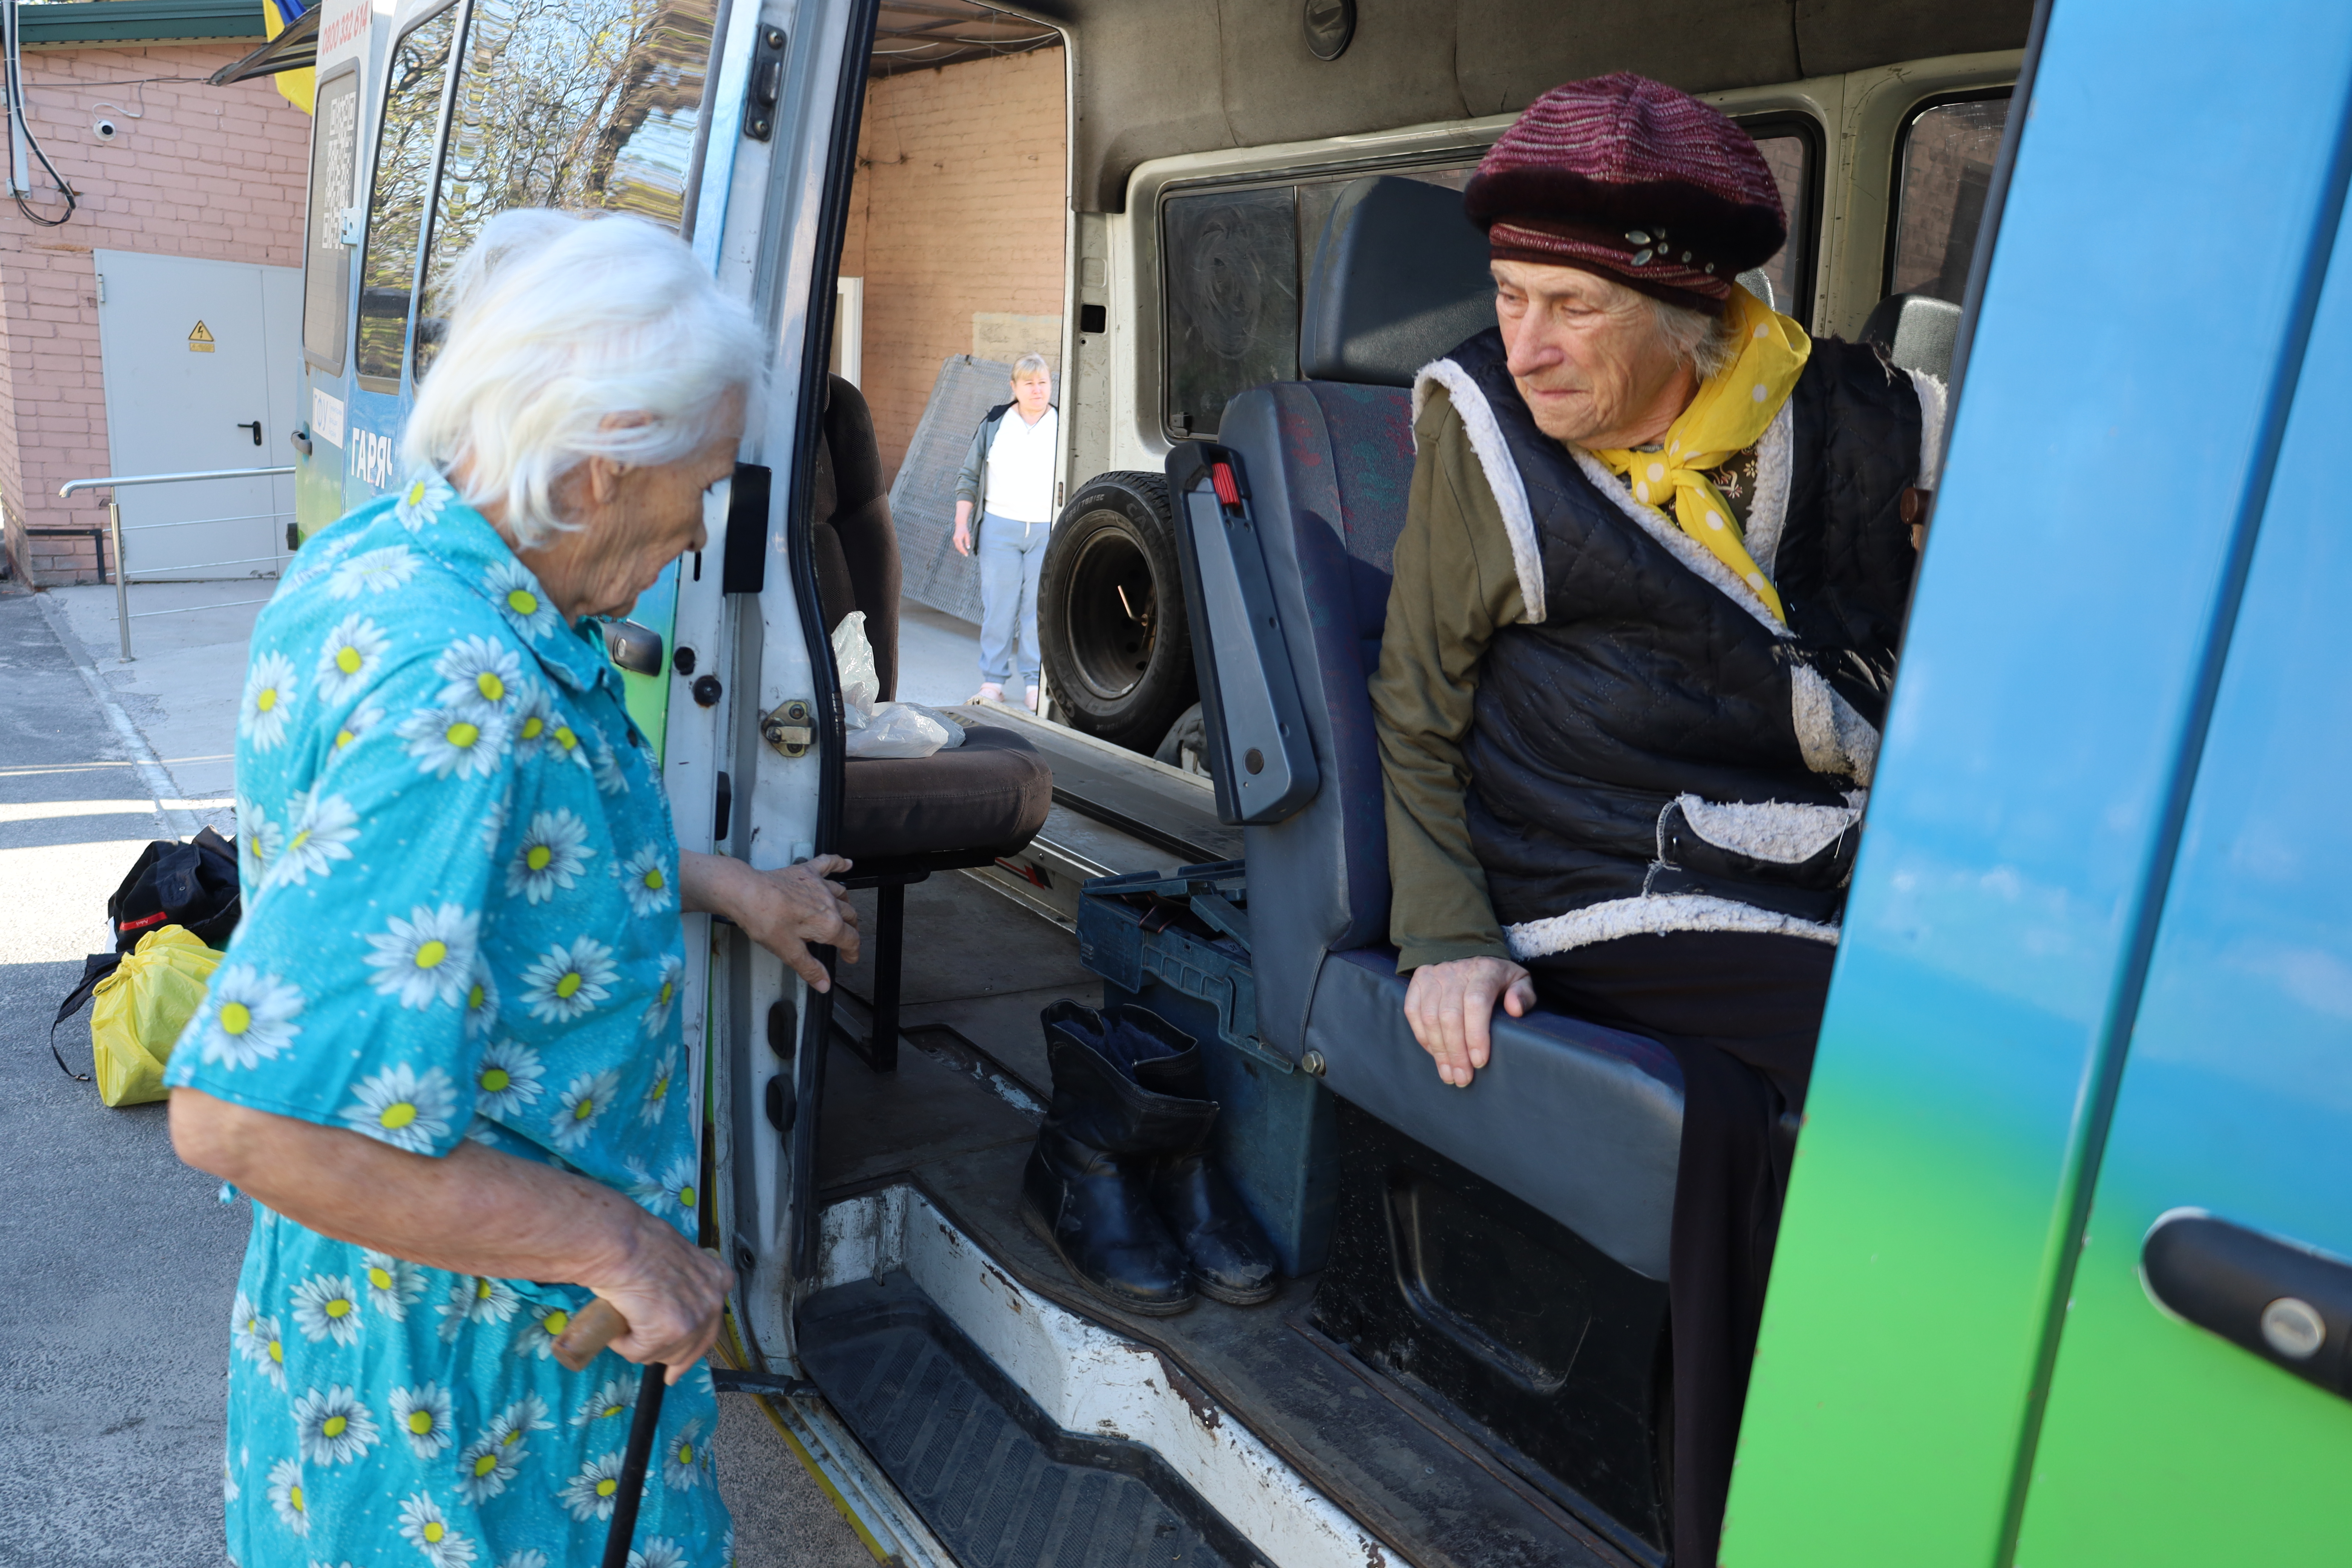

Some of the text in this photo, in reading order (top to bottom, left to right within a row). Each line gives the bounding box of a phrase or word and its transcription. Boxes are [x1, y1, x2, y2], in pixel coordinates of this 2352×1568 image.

[322, 0, 368, 56] 0800 332 614
